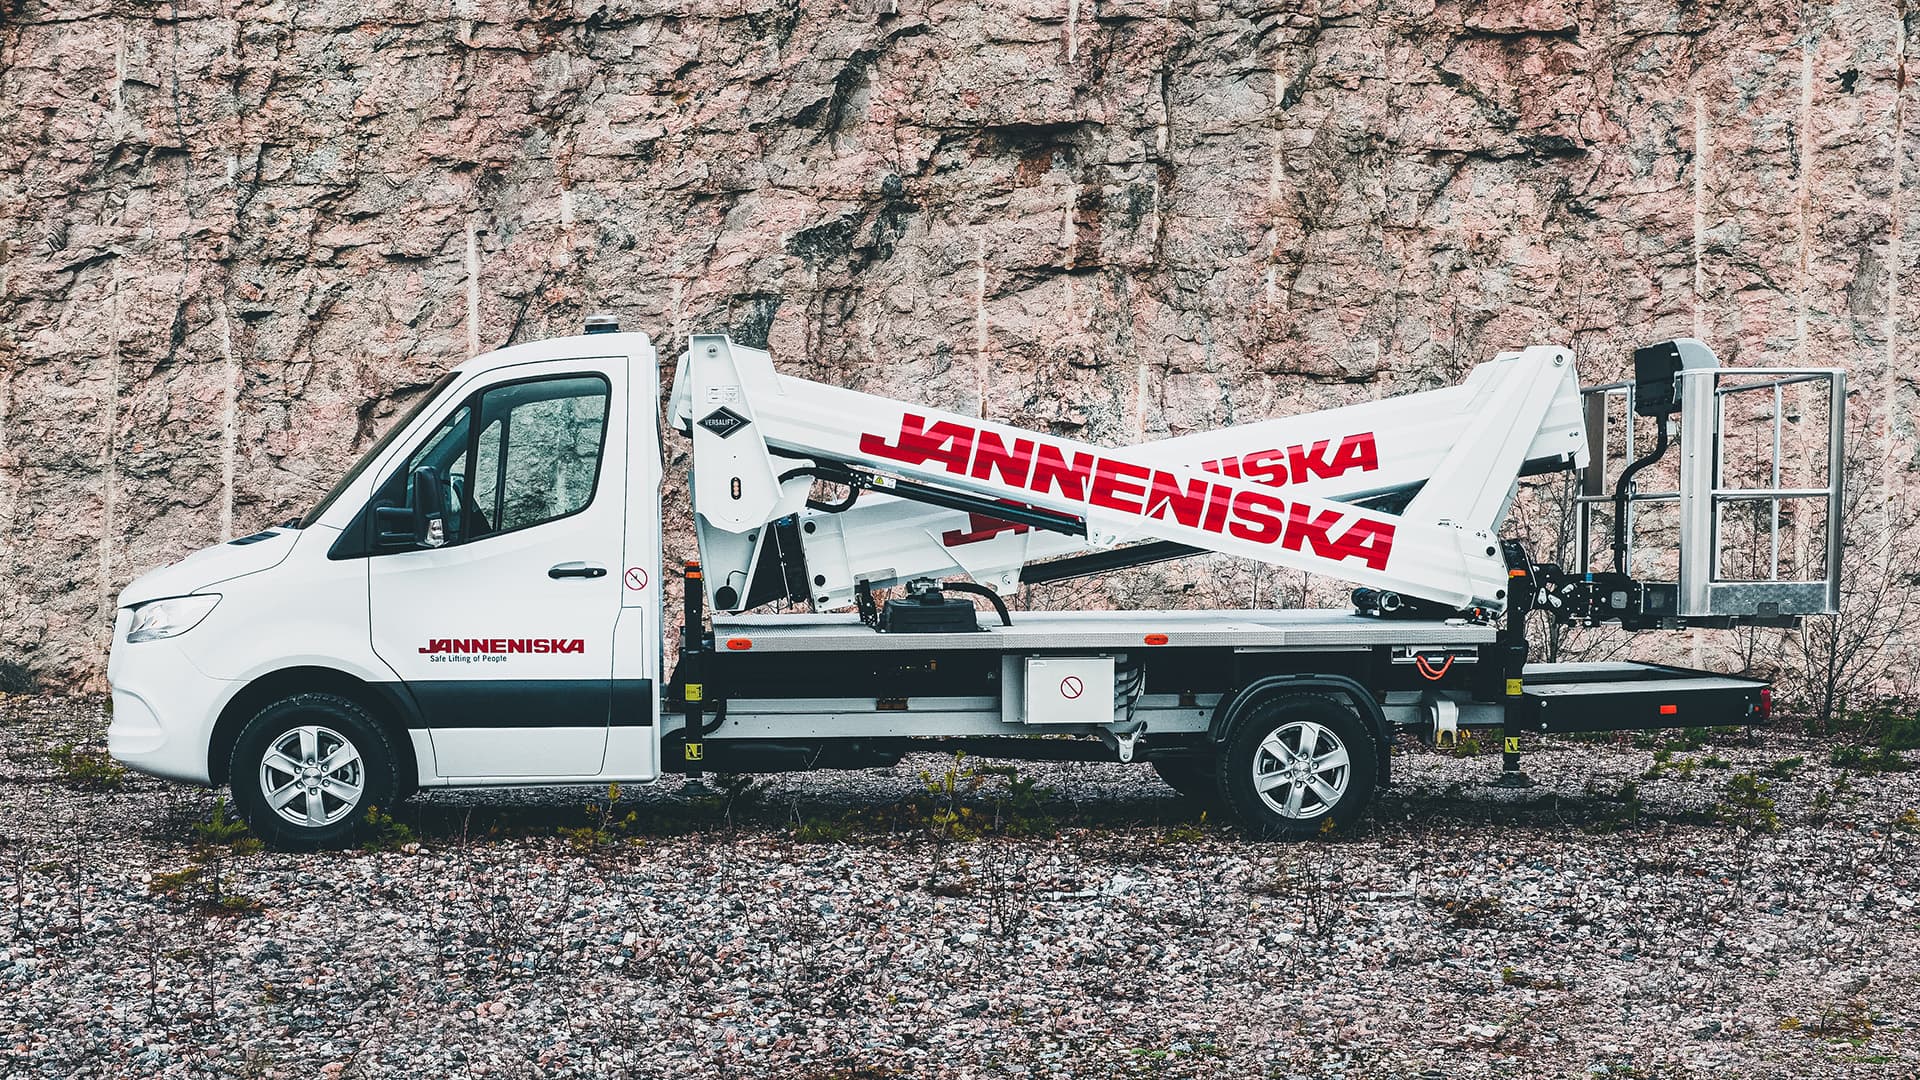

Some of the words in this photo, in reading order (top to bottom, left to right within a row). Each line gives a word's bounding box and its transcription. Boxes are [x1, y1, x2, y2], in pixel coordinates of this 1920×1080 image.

[704, 418, 734, 426] VERSALIFT
[859, 413, 1396, 571] JANNENISKA
[418, 639, 585, 654] JANNENISKA
[448, 655, 471, 664] Lifting
[482, 655, 507, 664] People
